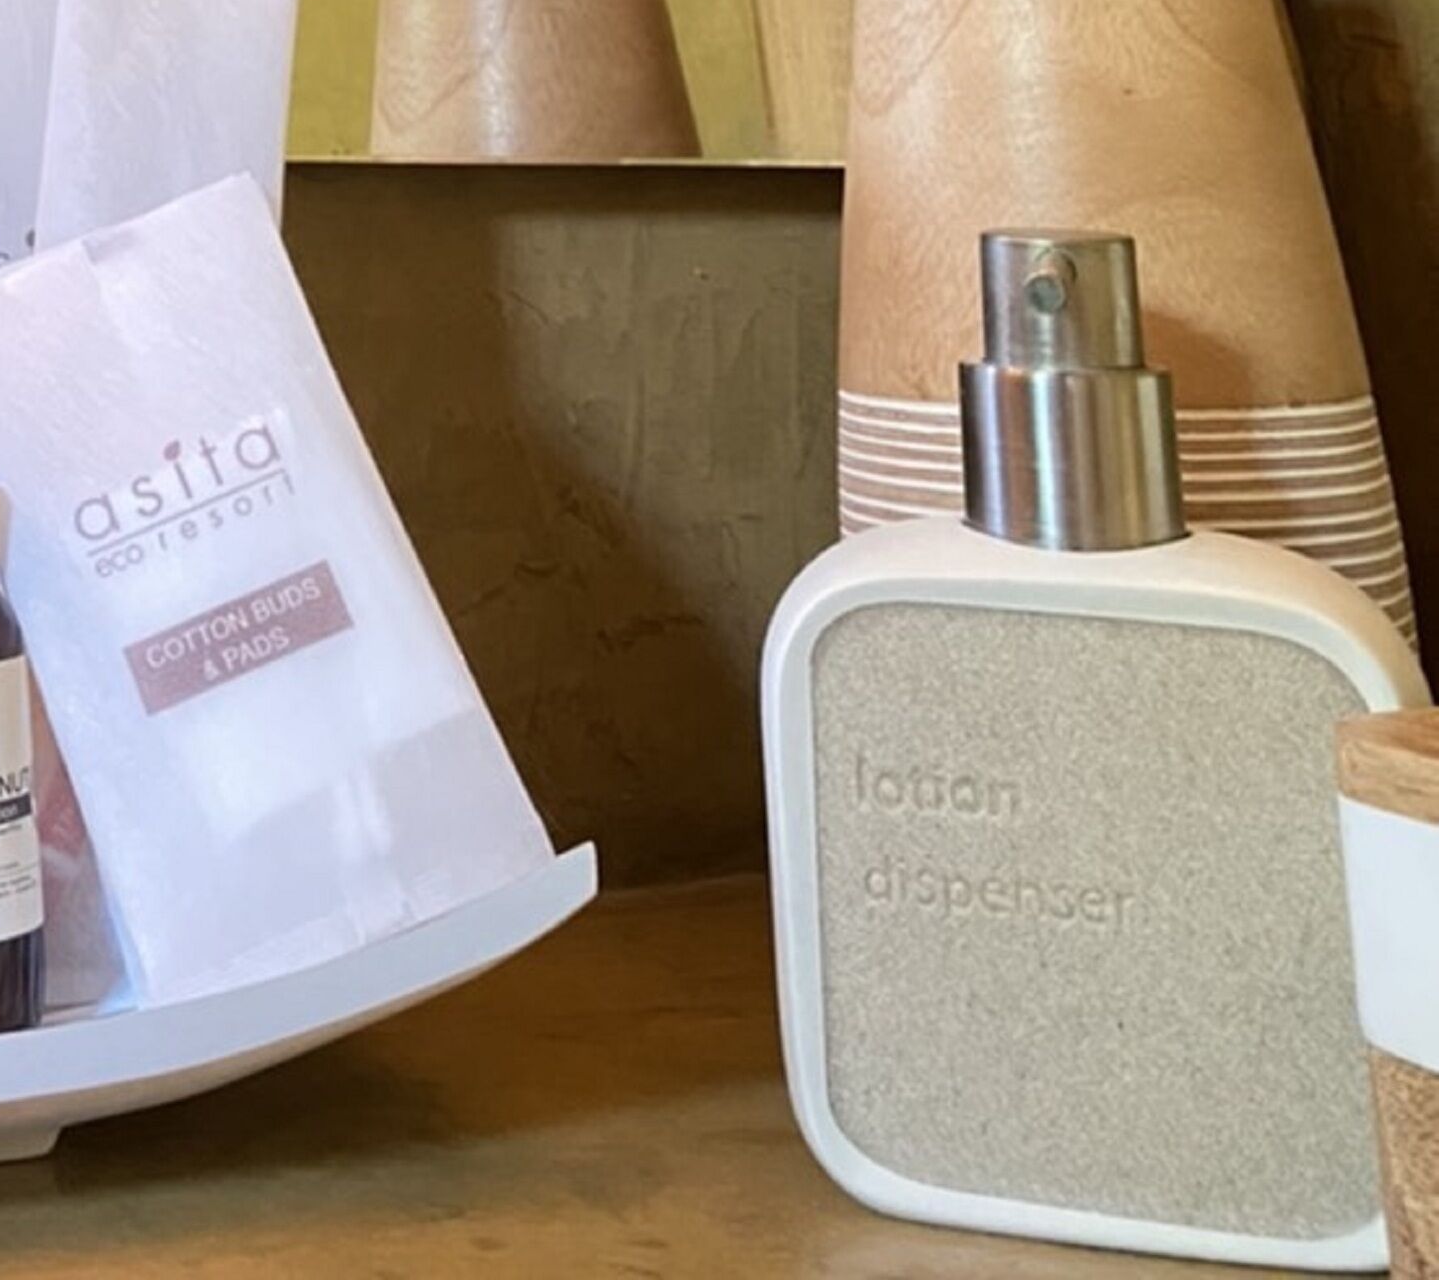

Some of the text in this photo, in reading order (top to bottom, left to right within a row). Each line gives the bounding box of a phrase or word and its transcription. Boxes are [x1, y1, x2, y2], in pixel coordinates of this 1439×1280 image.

[73, 423, 281, 541] asita
[94, 543, 144, 578] eco
[145, 577, 322, 669] COTTON BUDS
[221, 625, 291, 671] PADS
[856, 752, 1019, 818] lotion
[864, 853, 1136, 930] dispenser
